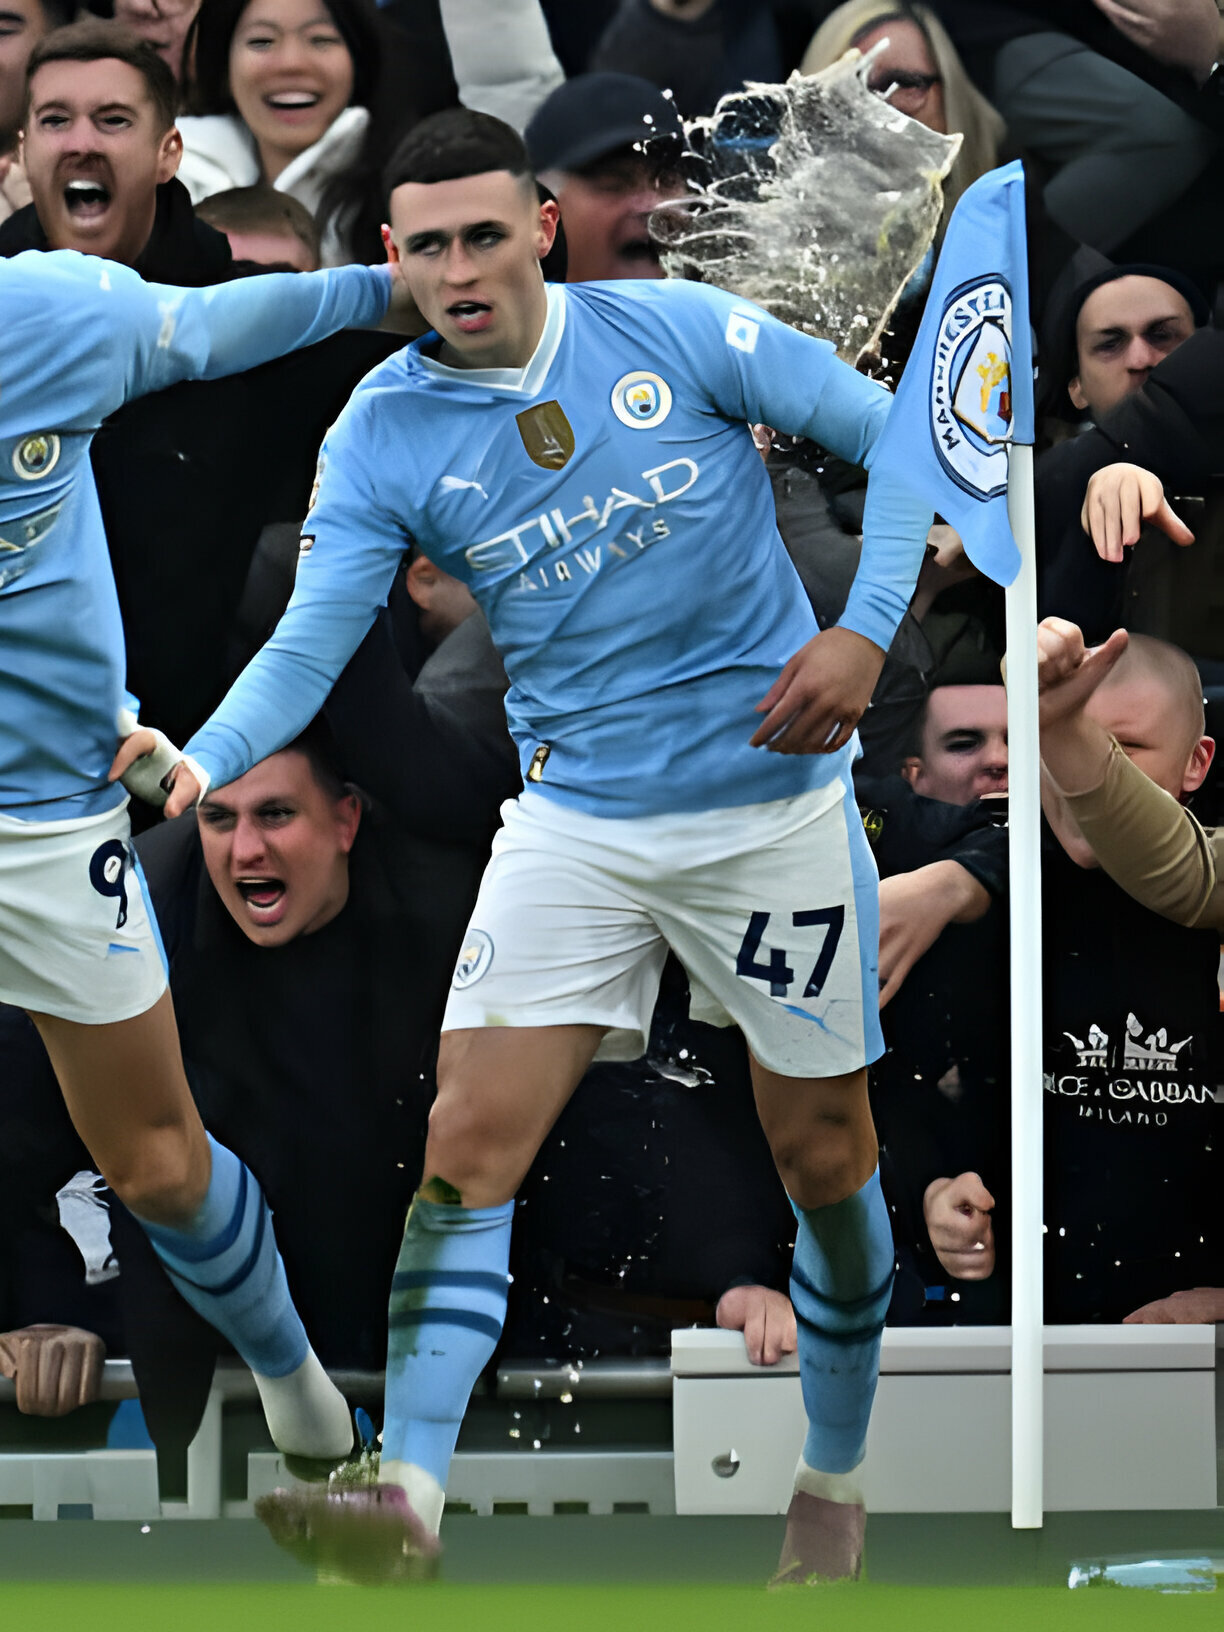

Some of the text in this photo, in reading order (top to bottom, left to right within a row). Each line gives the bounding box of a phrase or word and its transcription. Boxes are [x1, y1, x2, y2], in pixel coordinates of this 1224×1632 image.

[465, 457, 699, 570] ETIHAD
[519, 518, 672, 592] AIRWAYS
[88, 838, 133, 930] 9
[736, 904, 845, 998] 47
